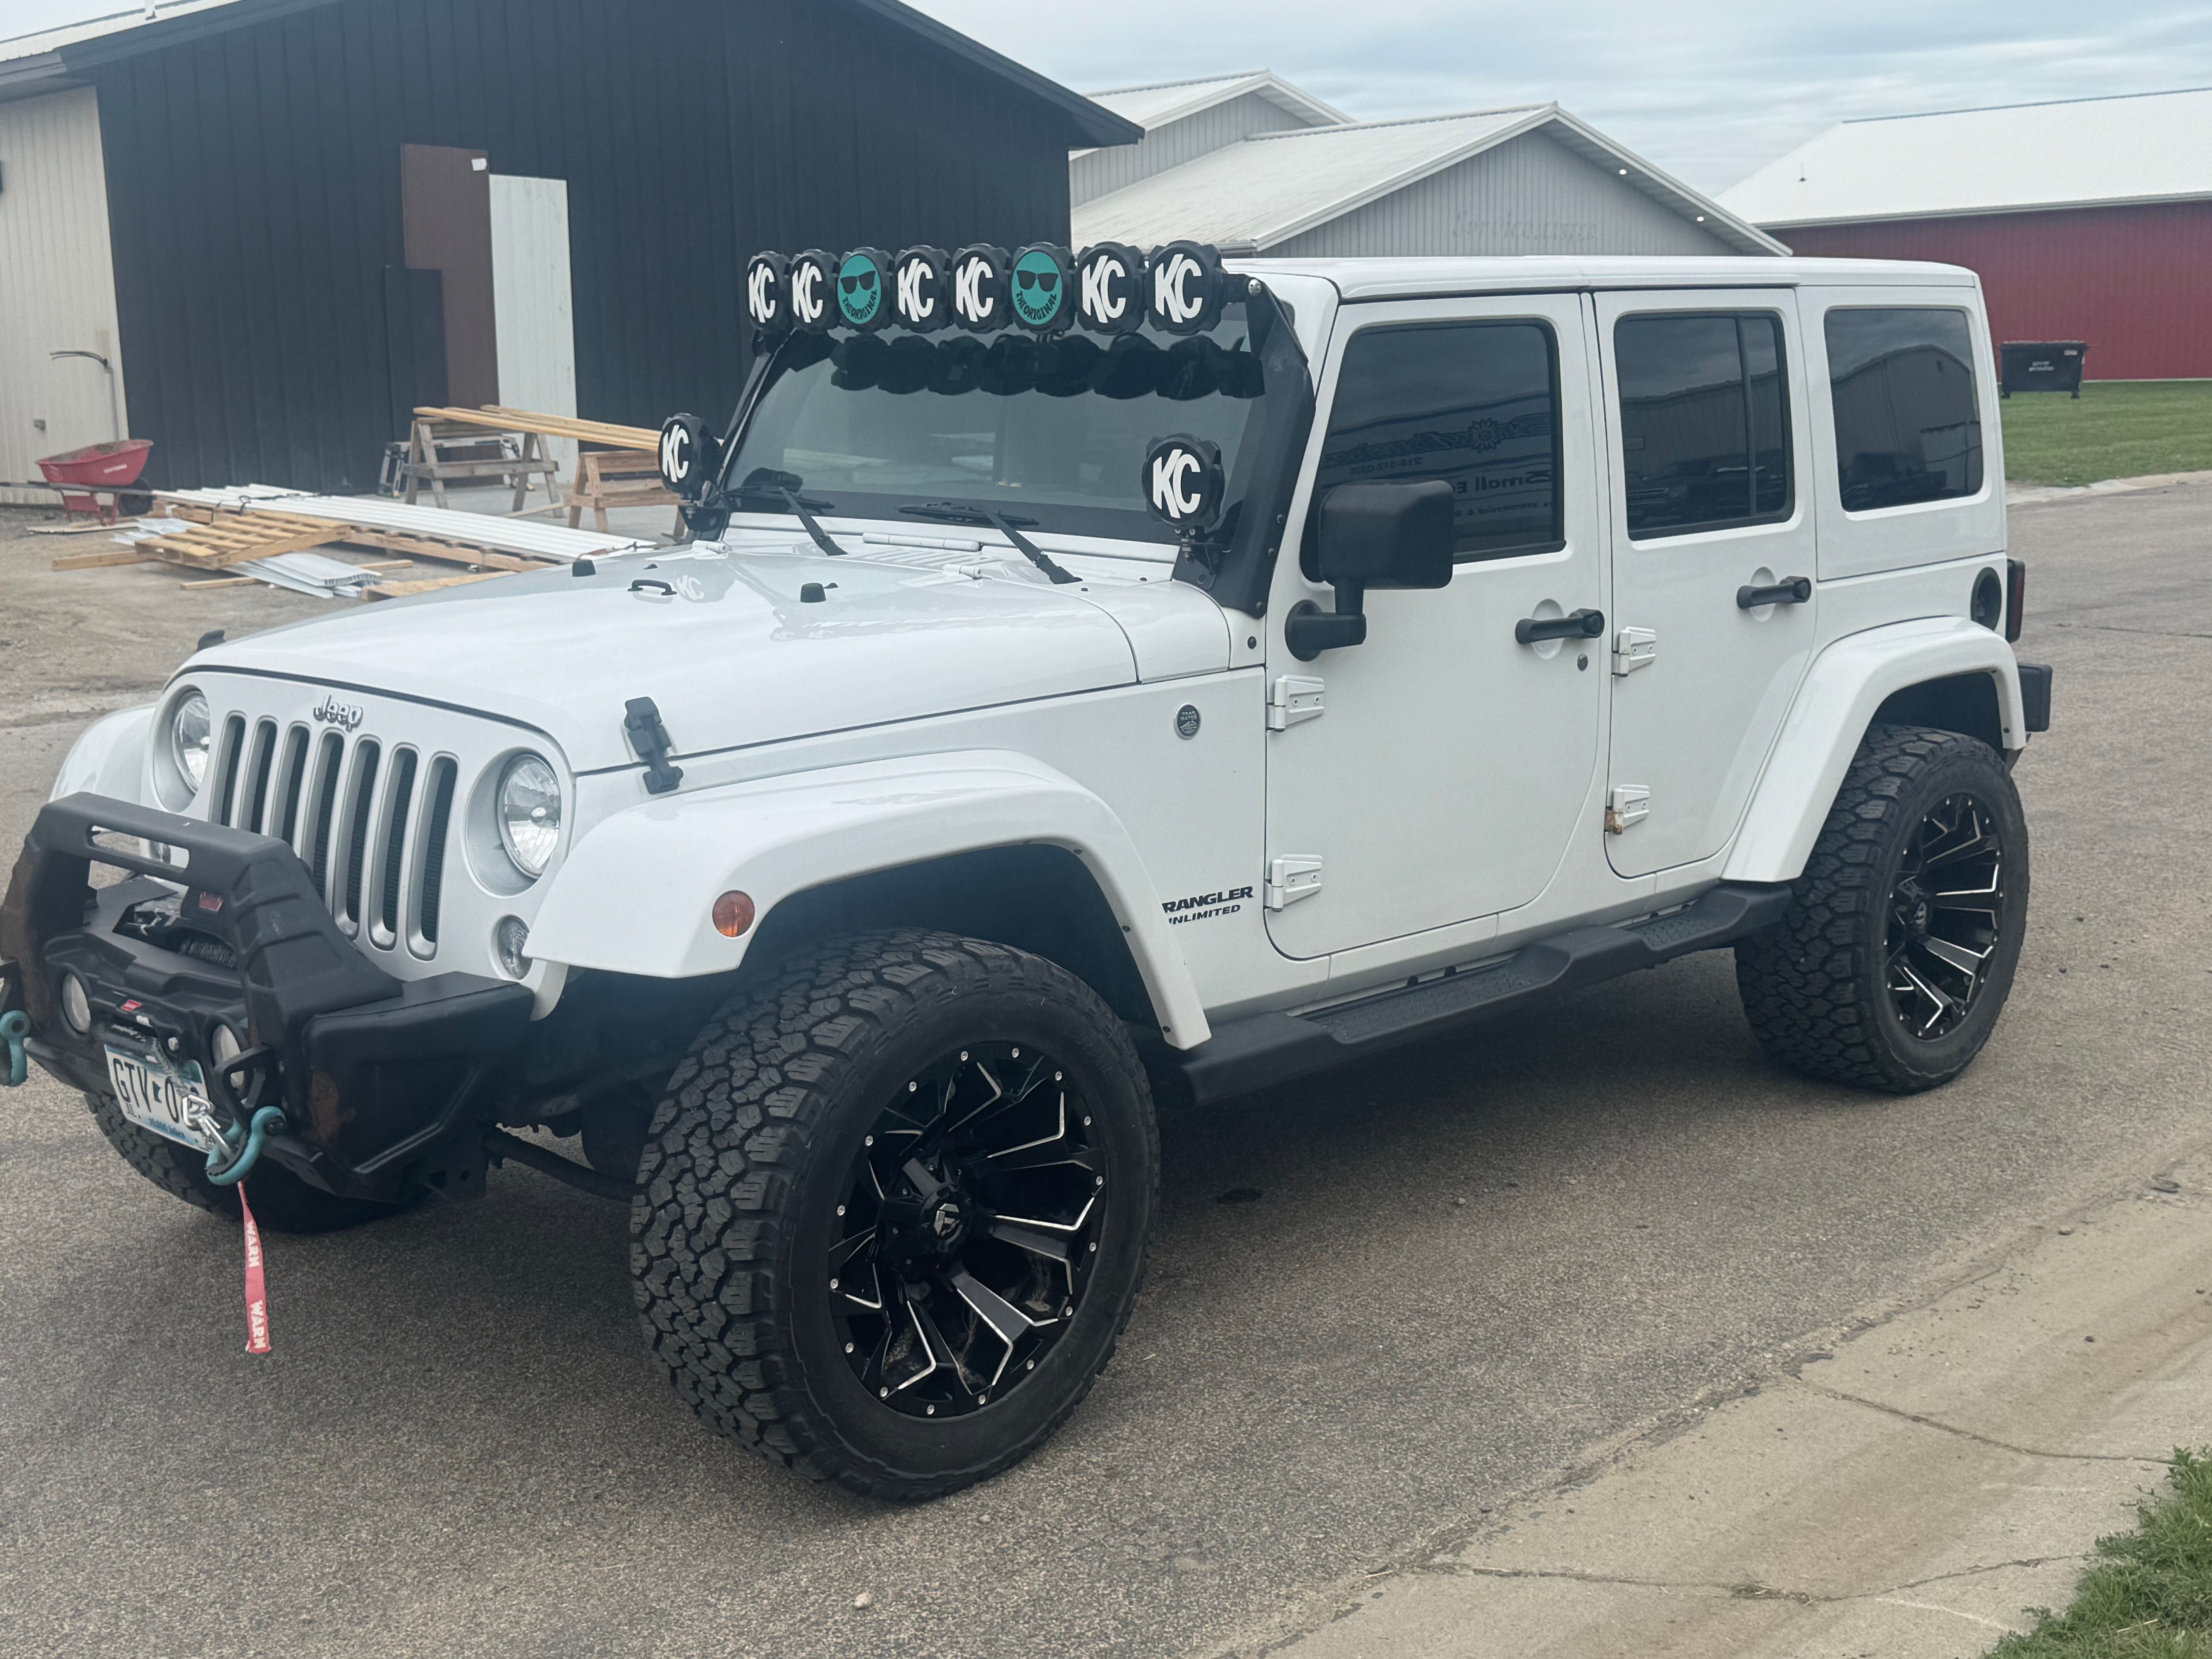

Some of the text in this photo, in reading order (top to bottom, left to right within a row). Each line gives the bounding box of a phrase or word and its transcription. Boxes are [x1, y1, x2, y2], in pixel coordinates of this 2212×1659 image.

[749, 264, 775, 323] KC
[792, 262, 823, 323] KC
[851, 289, 877, 320] ORIGINAL
[898, 259, 934, 322] KC
[956, 257, 993, 322] KC
[1016, 291, 1057, 320] THE ORIGINAL
[1082, 256, 1126, 323] KC
[1156, 254, 1202, 323] KC
[663, 425, 689, 482] KC
[1153, 449, 1200, 518] KC
[313, 695, 363, 732] Jeep
[1162, 886, 1254, 914] RANGLER
[247, 1219, 261, 1268] WARN
[250, 1300, 266, 1349] WARN
